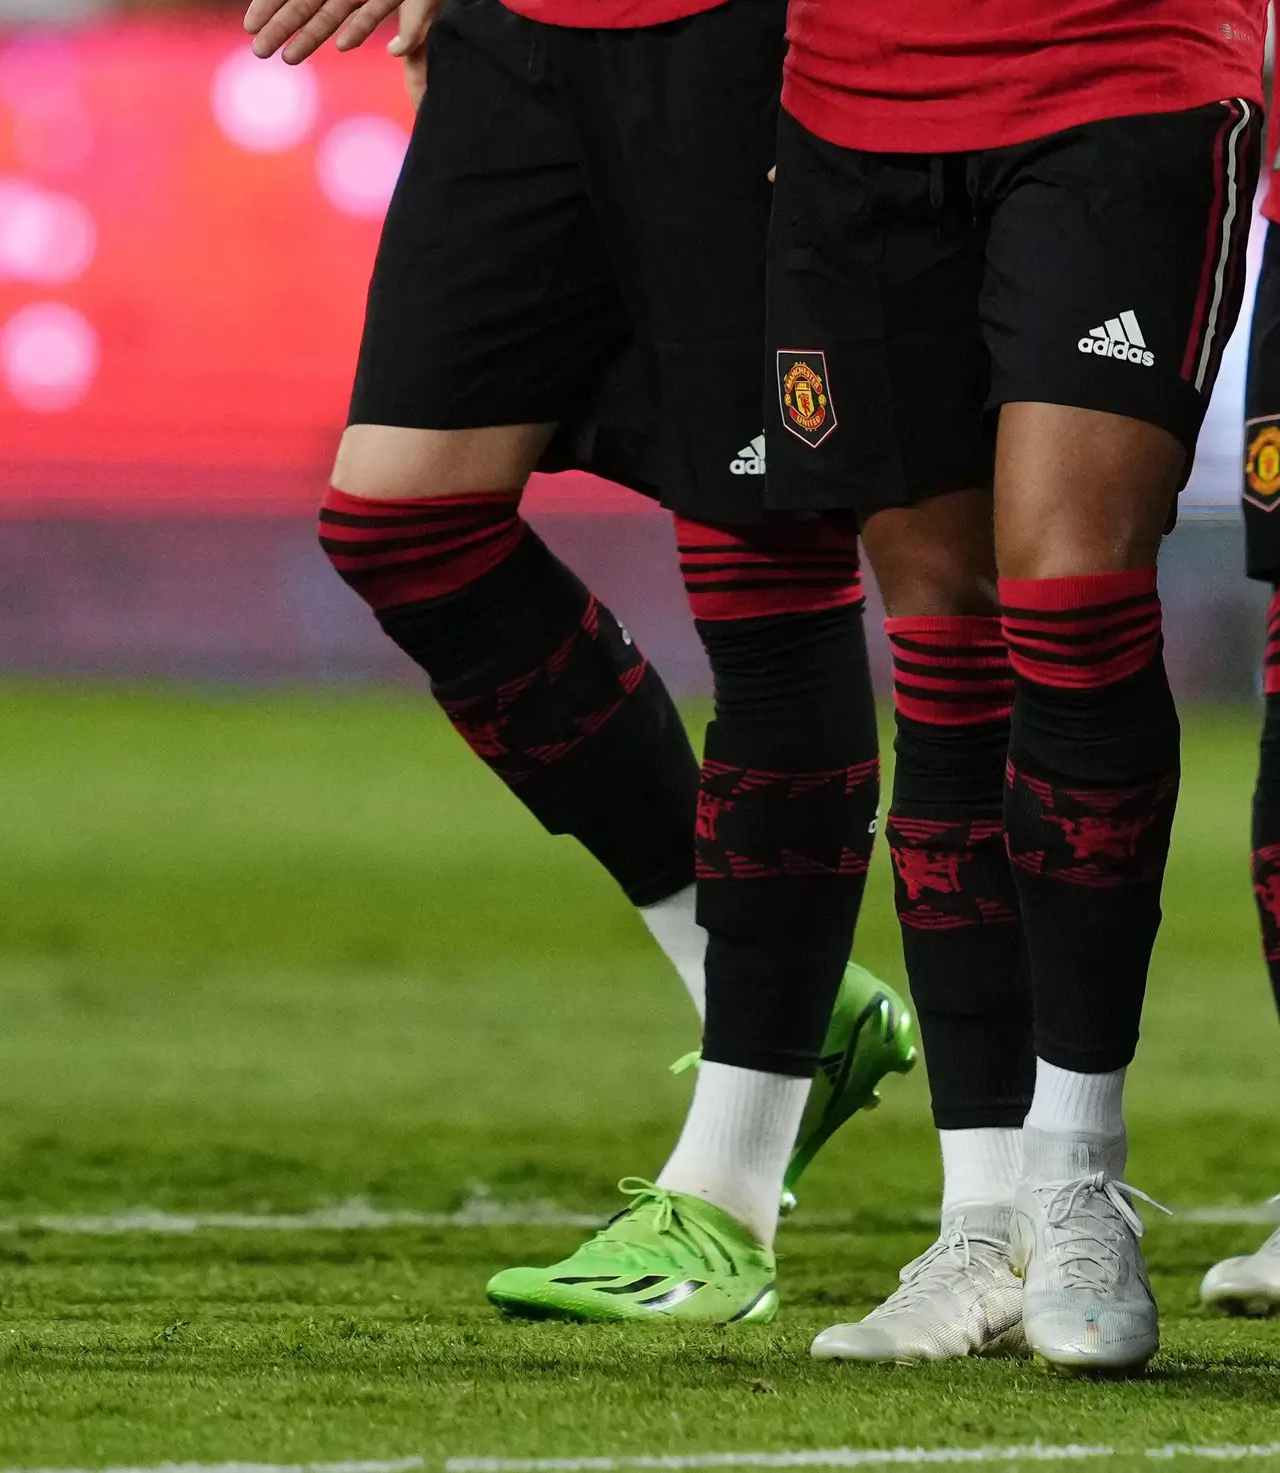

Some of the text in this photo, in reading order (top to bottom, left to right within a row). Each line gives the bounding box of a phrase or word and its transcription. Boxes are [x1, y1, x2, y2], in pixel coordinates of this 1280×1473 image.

[1078, 336, 1155, 367] adidas
[786, 367, 820, 389] MANCHESTER
[797, 415, 821, 427] UNITED
